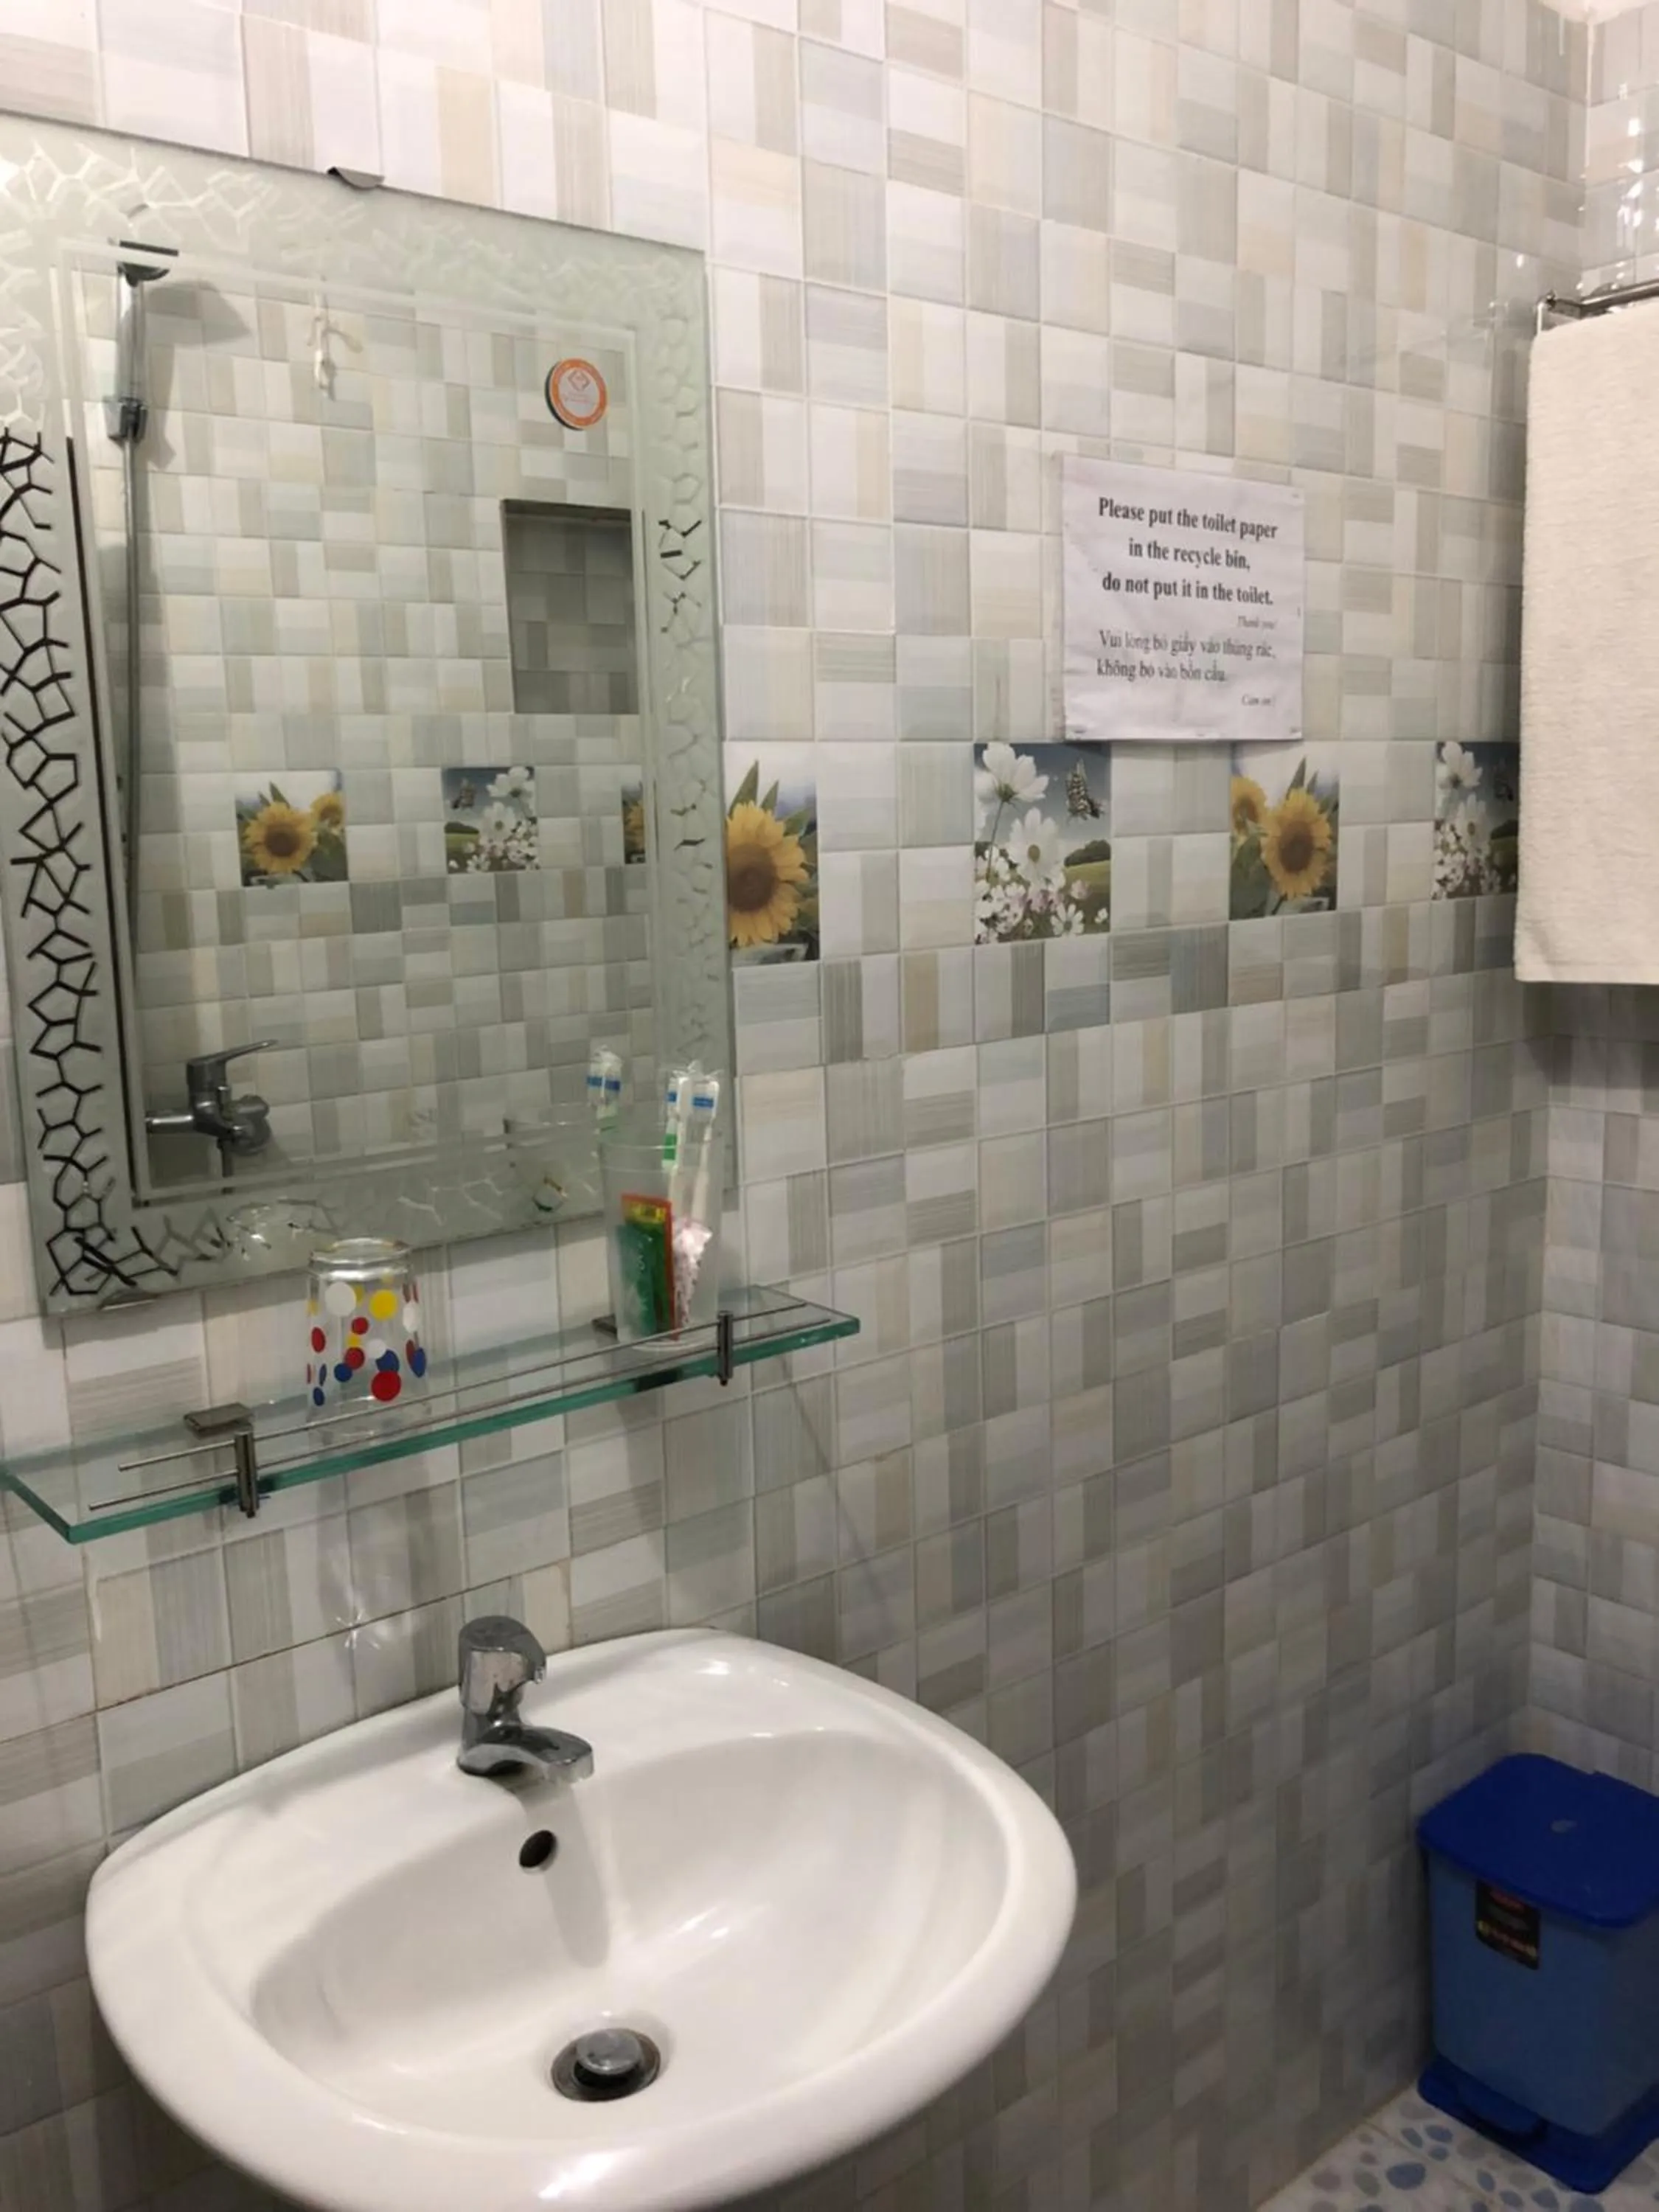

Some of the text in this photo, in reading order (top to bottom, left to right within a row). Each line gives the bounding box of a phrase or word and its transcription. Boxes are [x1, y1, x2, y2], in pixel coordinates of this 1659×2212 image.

[1099, 497, 1278, 541] Please put the toilet paper
[1129, 538, 1250, 571] in the recycle bin,
[1102, 571, 1273, 605] do not put it in the toilet.
